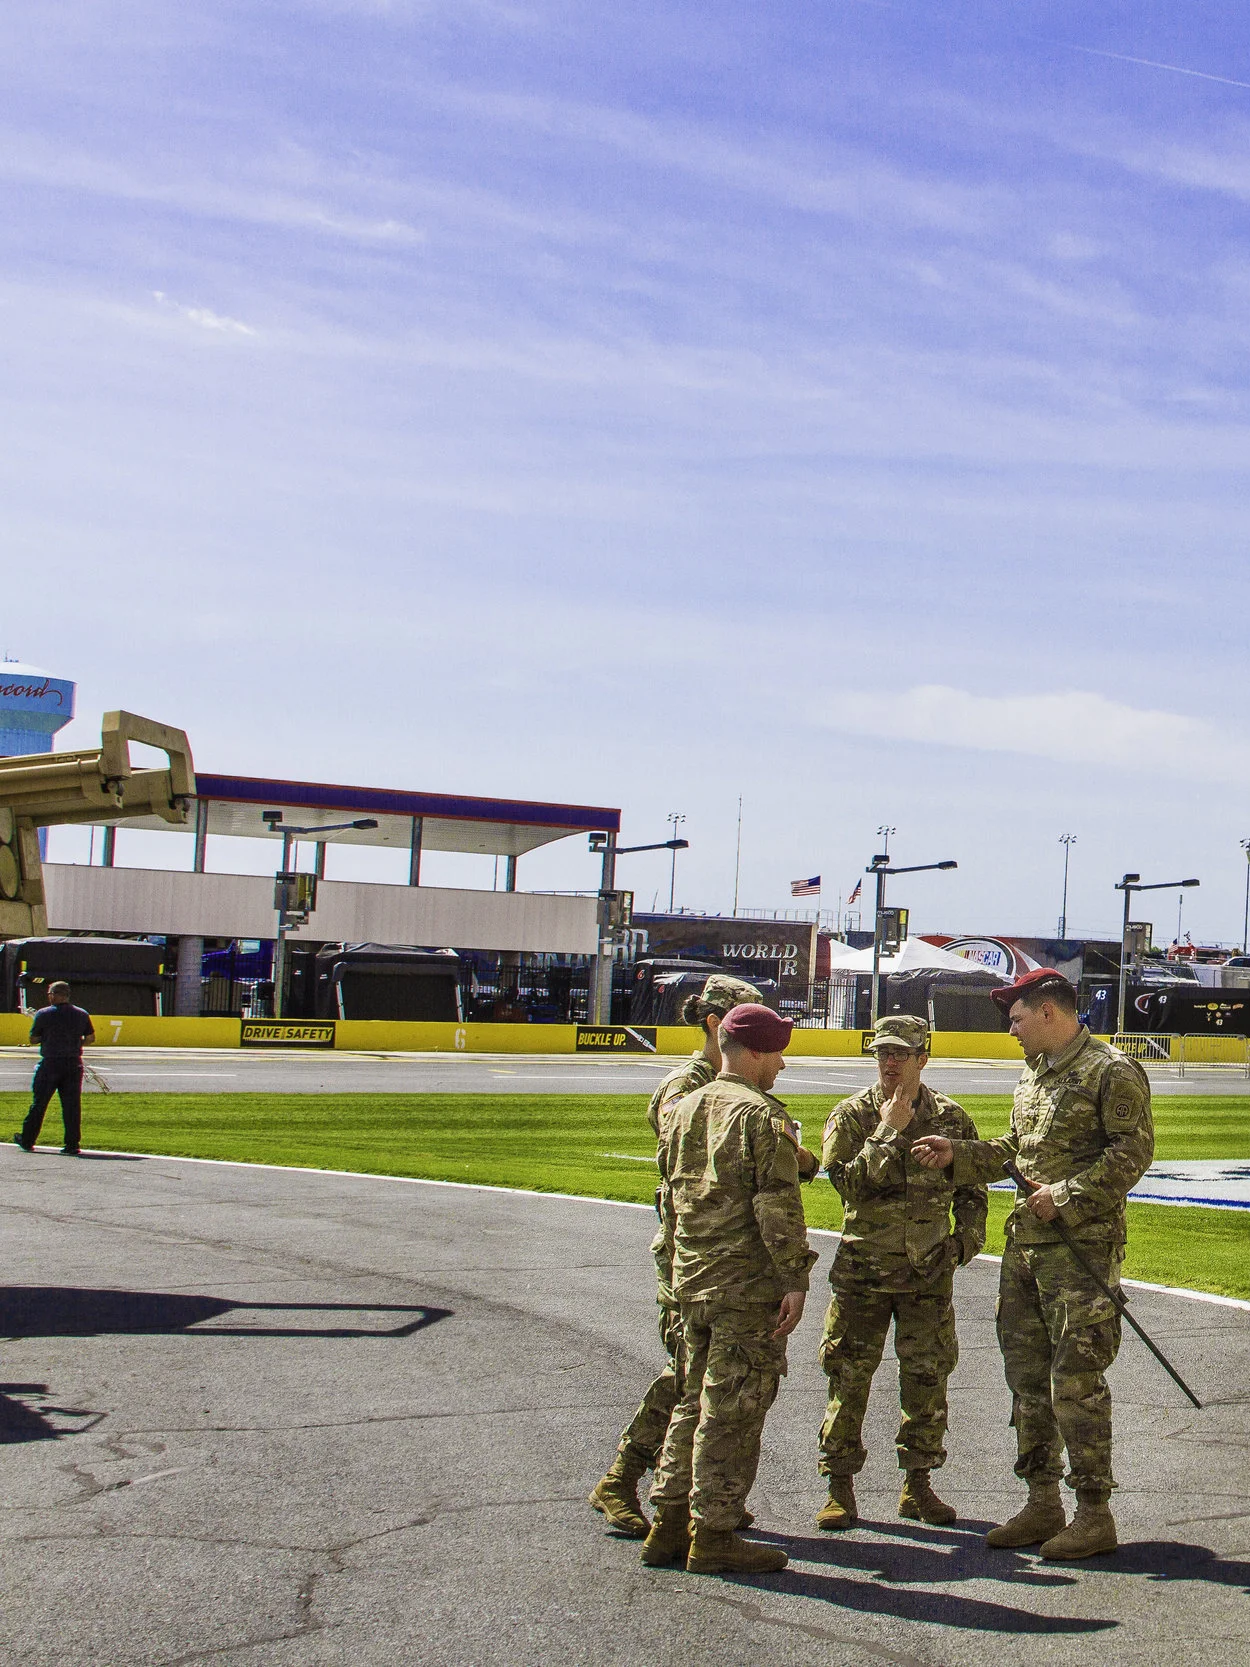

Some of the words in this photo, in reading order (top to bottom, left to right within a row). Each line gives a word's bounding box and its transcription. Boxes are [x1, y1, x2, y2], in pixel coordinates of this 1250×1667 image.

[721, 943, 798, 959] WORLD
[1095, 989, 1107, 1000] 43
[1158, 995, 1168, 1004] 43
[110, 1020, 123, 1043] 7
[244, 1027, 281, 1038] DRIVE
[286, 1028, 333, 1039] SAFETY
[454, 1028, 466, 1049] 6
[578, 1032, 611, 1046] BUCKLE
